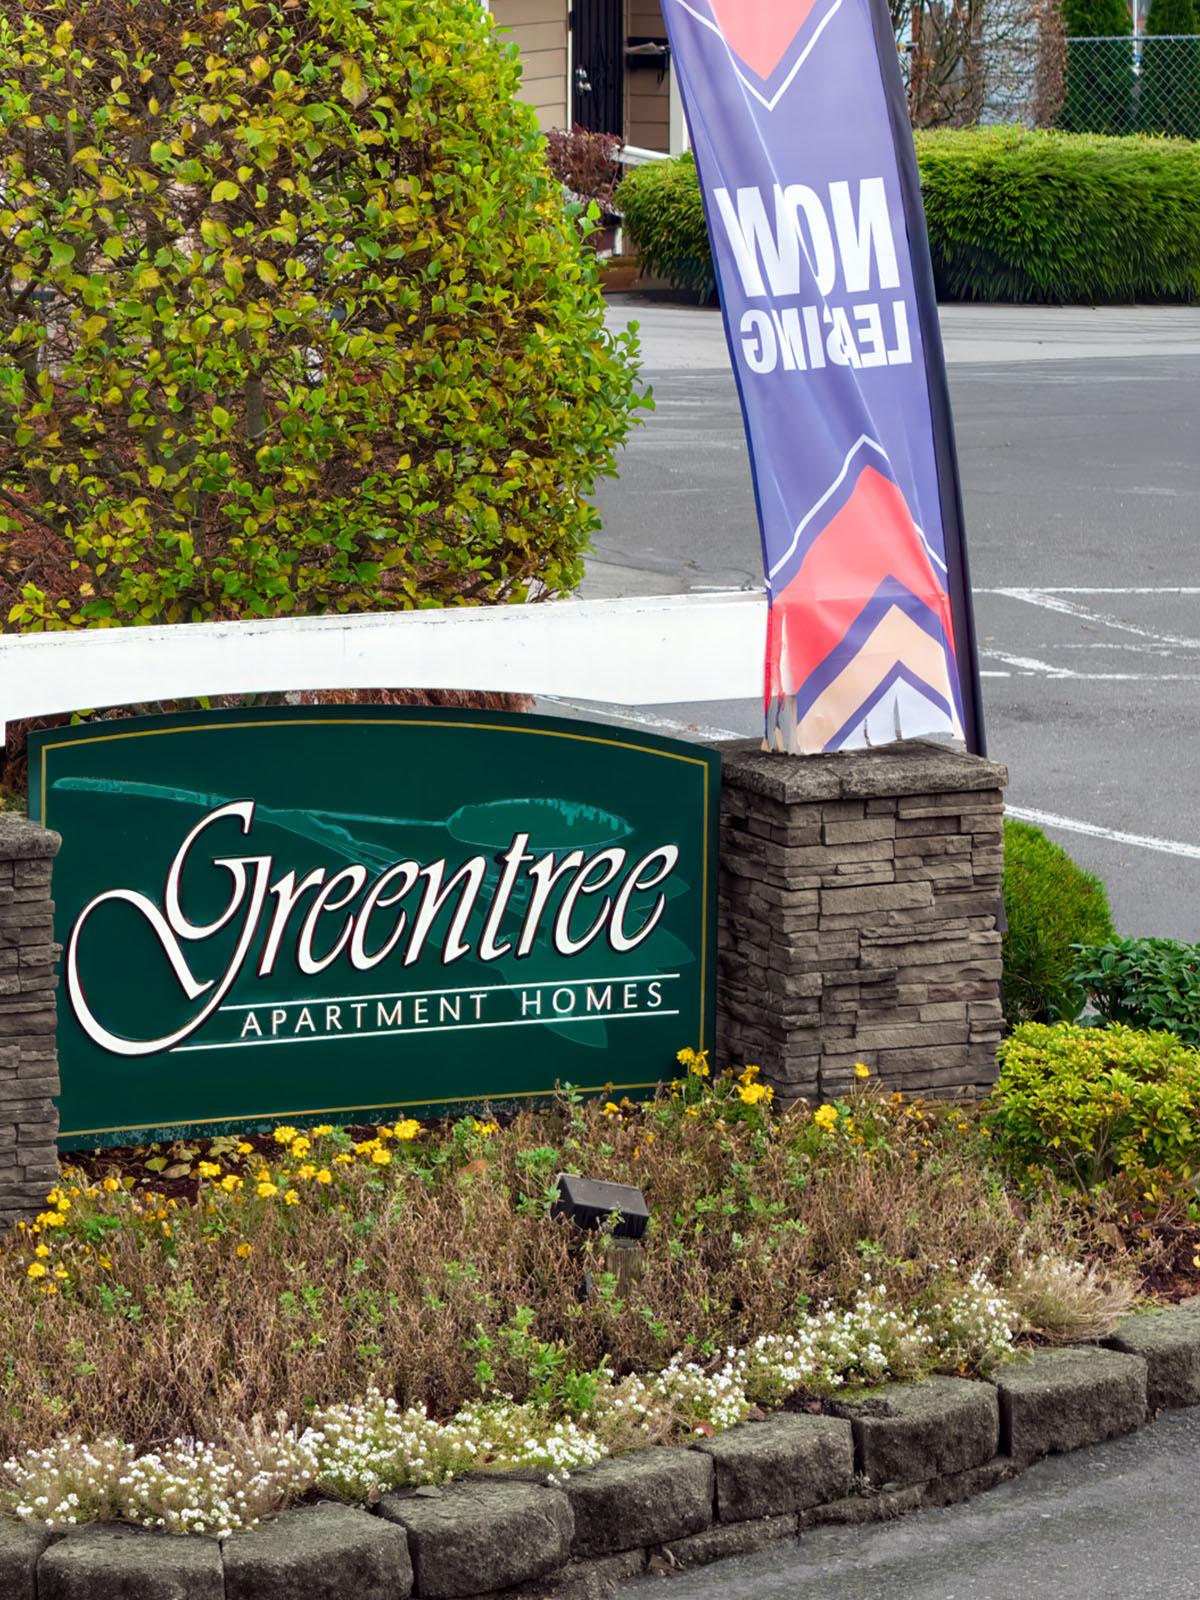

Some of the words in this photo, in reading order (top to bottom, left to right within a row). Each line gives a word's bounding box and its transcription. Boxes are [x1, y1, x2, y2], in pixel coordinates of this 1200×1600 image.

[67, 799, 680, 1055] Greentree
[241, 993, 488, 1037] APARTMENT
[521, 981, 664, 1016] HOMES
